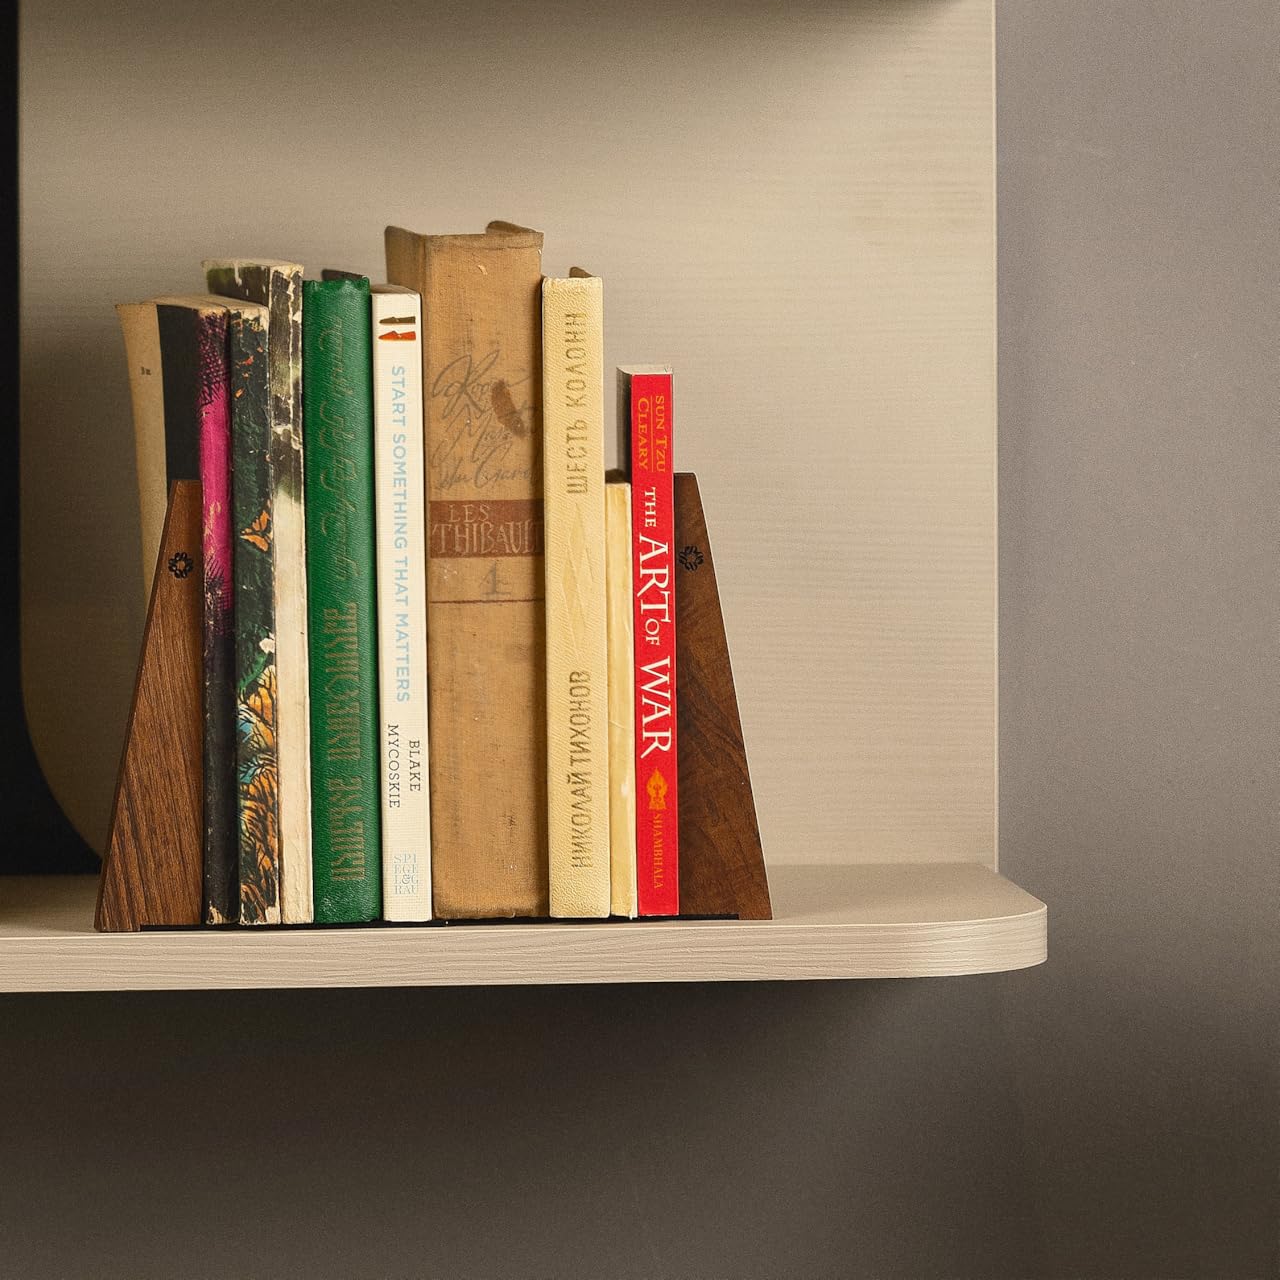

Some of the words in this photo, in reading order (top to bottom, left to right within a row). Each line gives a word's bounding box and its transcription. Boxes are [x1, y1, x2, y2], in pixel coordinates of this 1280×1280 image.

[390, 365, 408, 427] START
[564, 311, 588, 408] КОЛОНН
[637, 396, 652, 471] CLEARY
[654, 395, 666, 434] SUN
[391, 433, 409, 550] SOMETHING
[564, 419, 589, 495] ШЕСТЬ
[654, 436, 667, 473] TZU
[449, 504, 490, 523] LES
[644, 487, 658, 528] THE
[393, 556, 410, 609] THAT
[637, 533, 670, 623] ART
[394, 613, 411, 703] MATTERS
[643, 617, 663, 647] OF
[568, 670, 592, 767] ТИХОНОВ
[639, 654, 672, 759] WAR
[387, 724, 401, 809] MYCOSKIE
[408, 739, 422, 793] BLAKE
[566, 771, 593, 869] НИКОЛАЙ
[651, 812, 666, 890] SHAMBHALA
